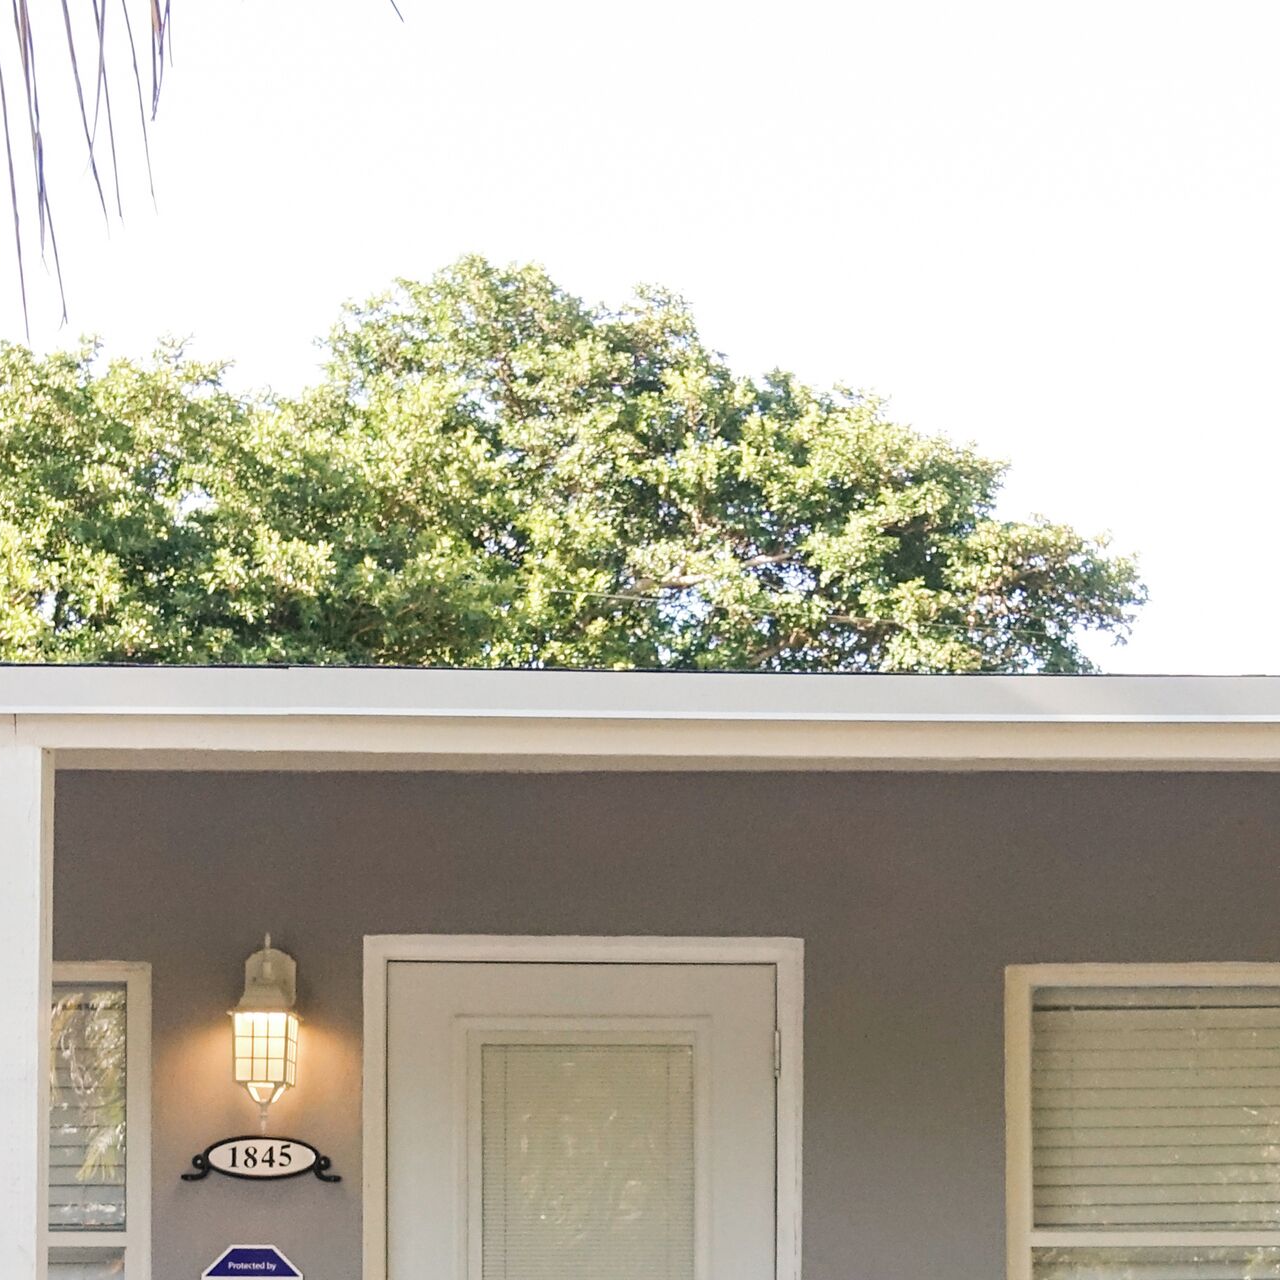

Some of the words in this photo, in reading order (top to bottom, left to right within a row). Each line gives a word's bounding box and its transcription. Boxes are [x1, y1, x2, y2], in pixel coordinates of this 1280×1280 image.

[228, 1144, 292, 1168] 1845
[227, 1261, 265, 1270] Protected
[266, 1261, 277, 1271] by
